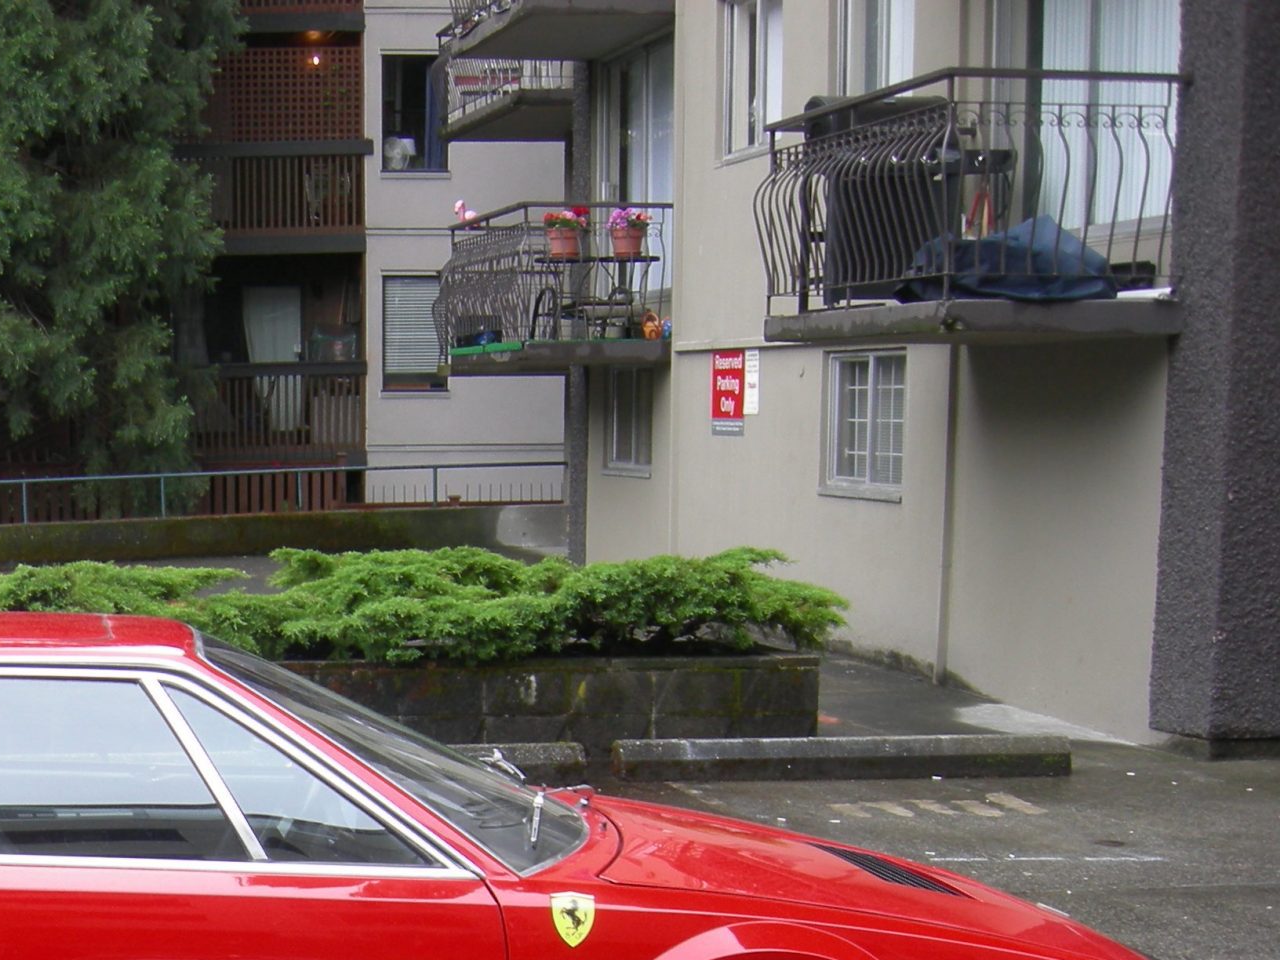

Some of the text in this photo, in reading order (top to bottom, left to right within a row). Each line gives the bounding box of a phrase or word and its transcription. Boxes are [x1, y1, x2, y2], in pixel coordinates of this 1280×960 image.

[714, 354, 743, 370] Reserved
[716, 375, 740, 395] Parking
[720, 396, 736, 416] Only
